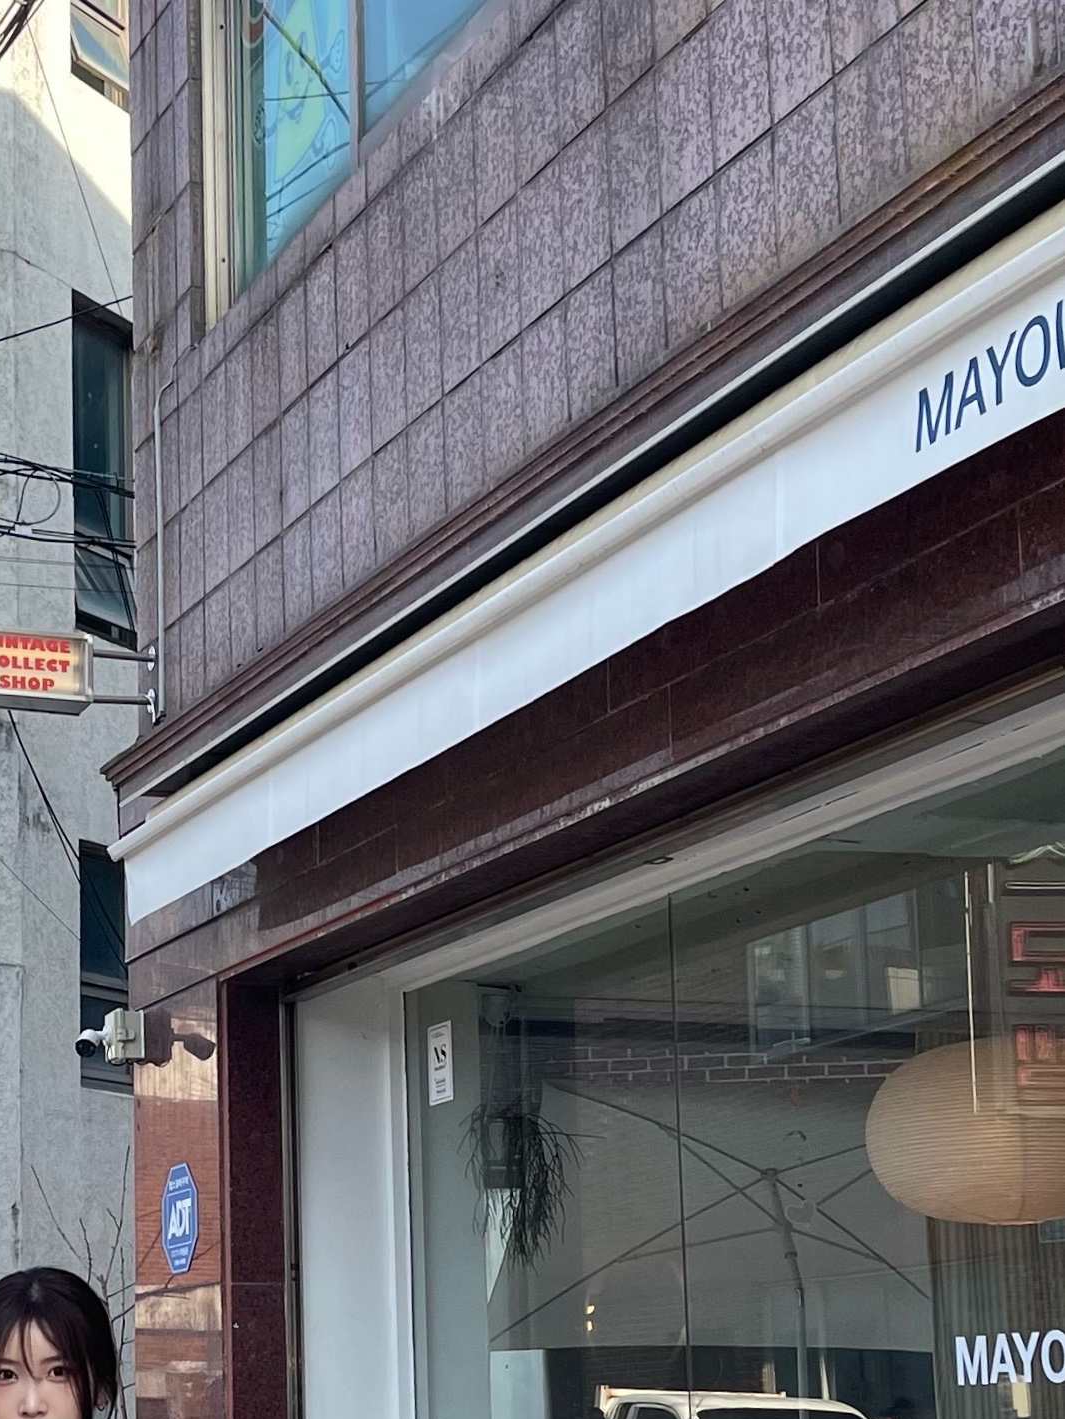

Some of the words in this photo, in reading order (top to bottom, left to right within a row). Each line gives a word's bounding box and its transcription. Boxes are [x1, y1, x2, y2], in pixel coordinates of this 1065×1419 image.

[0, 675, 55, 691] SHOP
[167, 1198, 192, 1240] ADT
[955, 1329, 1065, 1386] MAYO
